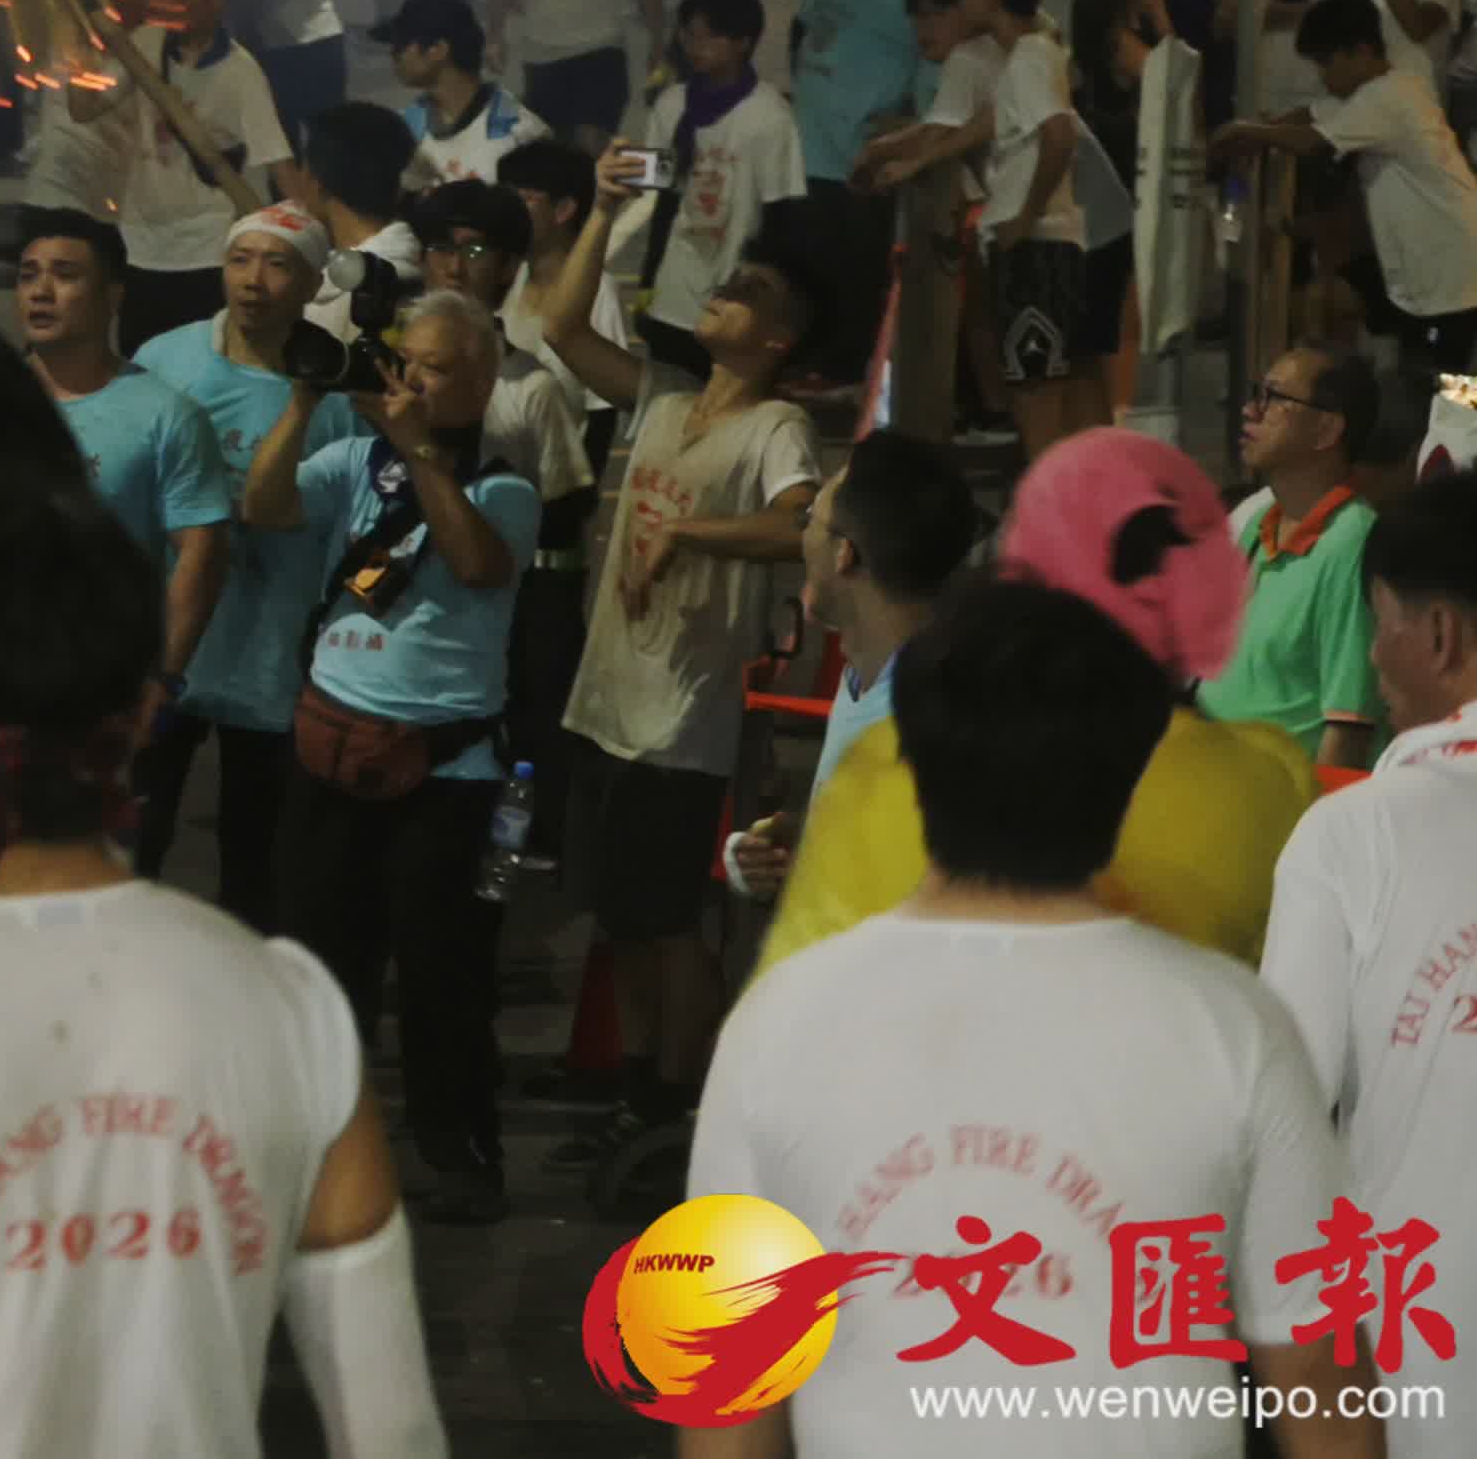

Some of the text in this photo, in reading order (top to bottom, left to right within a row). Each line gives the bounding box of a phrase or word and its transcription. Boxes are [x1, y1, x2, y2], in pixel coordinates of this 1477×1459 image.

[1390, 988, 1431, 1047] TAI
[1414, 924, 1477, 992] HAN
[3, 1208, 202, 1274] 2026
[74, 1093, 178, 1138] FIRE
[181, 1114, 268, 1277] DRAGON
[834, 1130, 934, 1242] HANG
[949, 1124, 1040, 1178] FIRE
[889, 1248, 1074, 1302] 26
